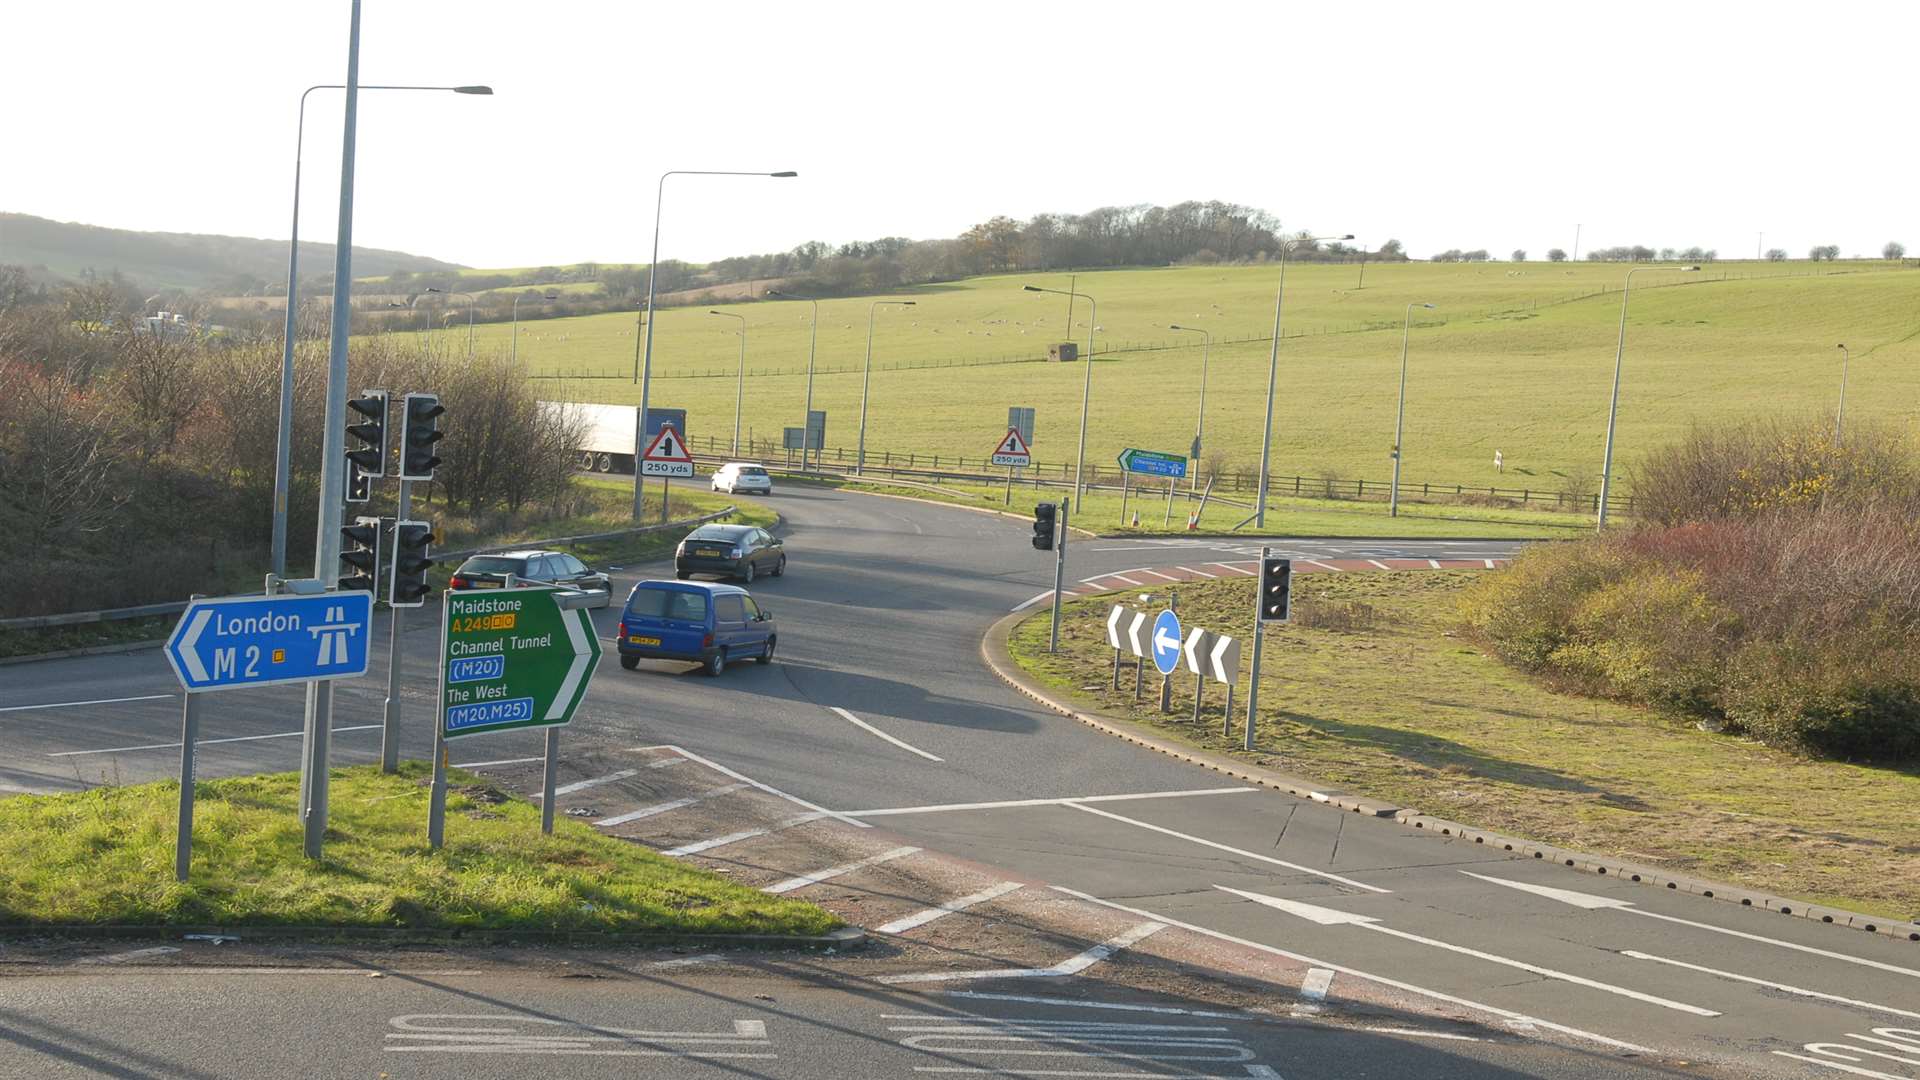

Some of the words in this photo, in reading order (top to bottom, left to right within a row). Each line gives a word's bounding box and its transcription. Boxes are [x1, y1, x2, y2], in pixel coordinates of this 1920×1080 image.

[647, 463, 669, 471] 250
[670, 464, 688, 473] yds
[452, 600, 522, 614] Maidstone
[217, 611, 300, 636] London
[450, 638, 504, 656] Channel
[510, 633, 551, 650] Tunnel
[453, 659, 499, 680] (M20)
[448, 688, 470, 703] The
[475, 684, 508, 700] West
